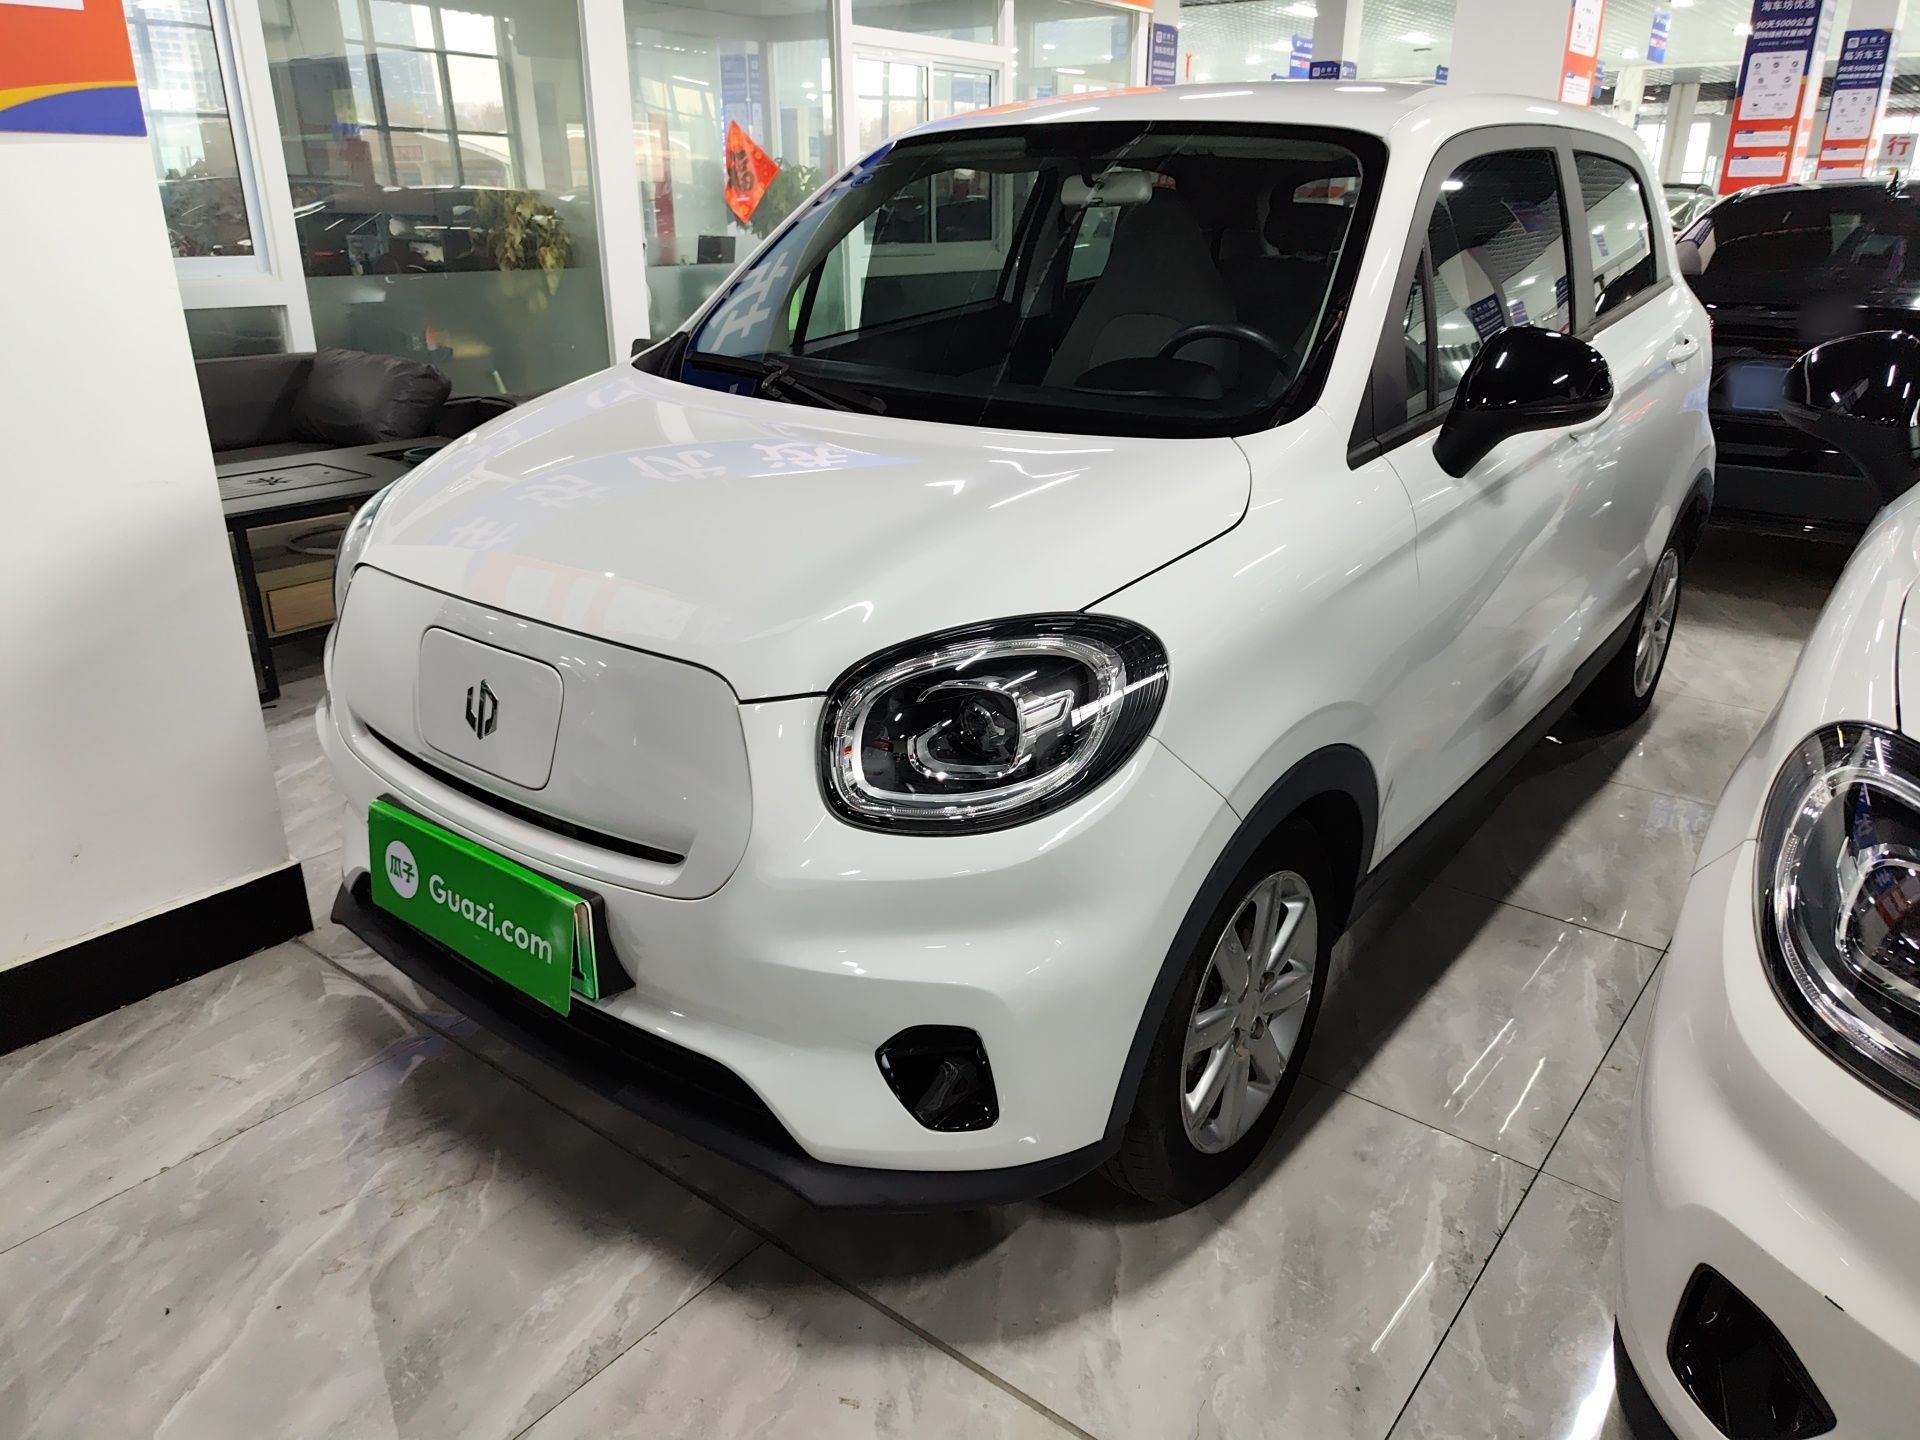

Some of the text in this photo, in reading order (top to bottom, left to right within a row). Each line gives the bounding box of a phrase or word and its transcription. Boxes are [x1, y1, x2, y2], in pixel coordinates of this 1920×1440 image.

[1887, 136, 1911, 155] 行
[390, 855, 415, 883] 瓜子
[429, 874, 553, 964] Guazi.com
